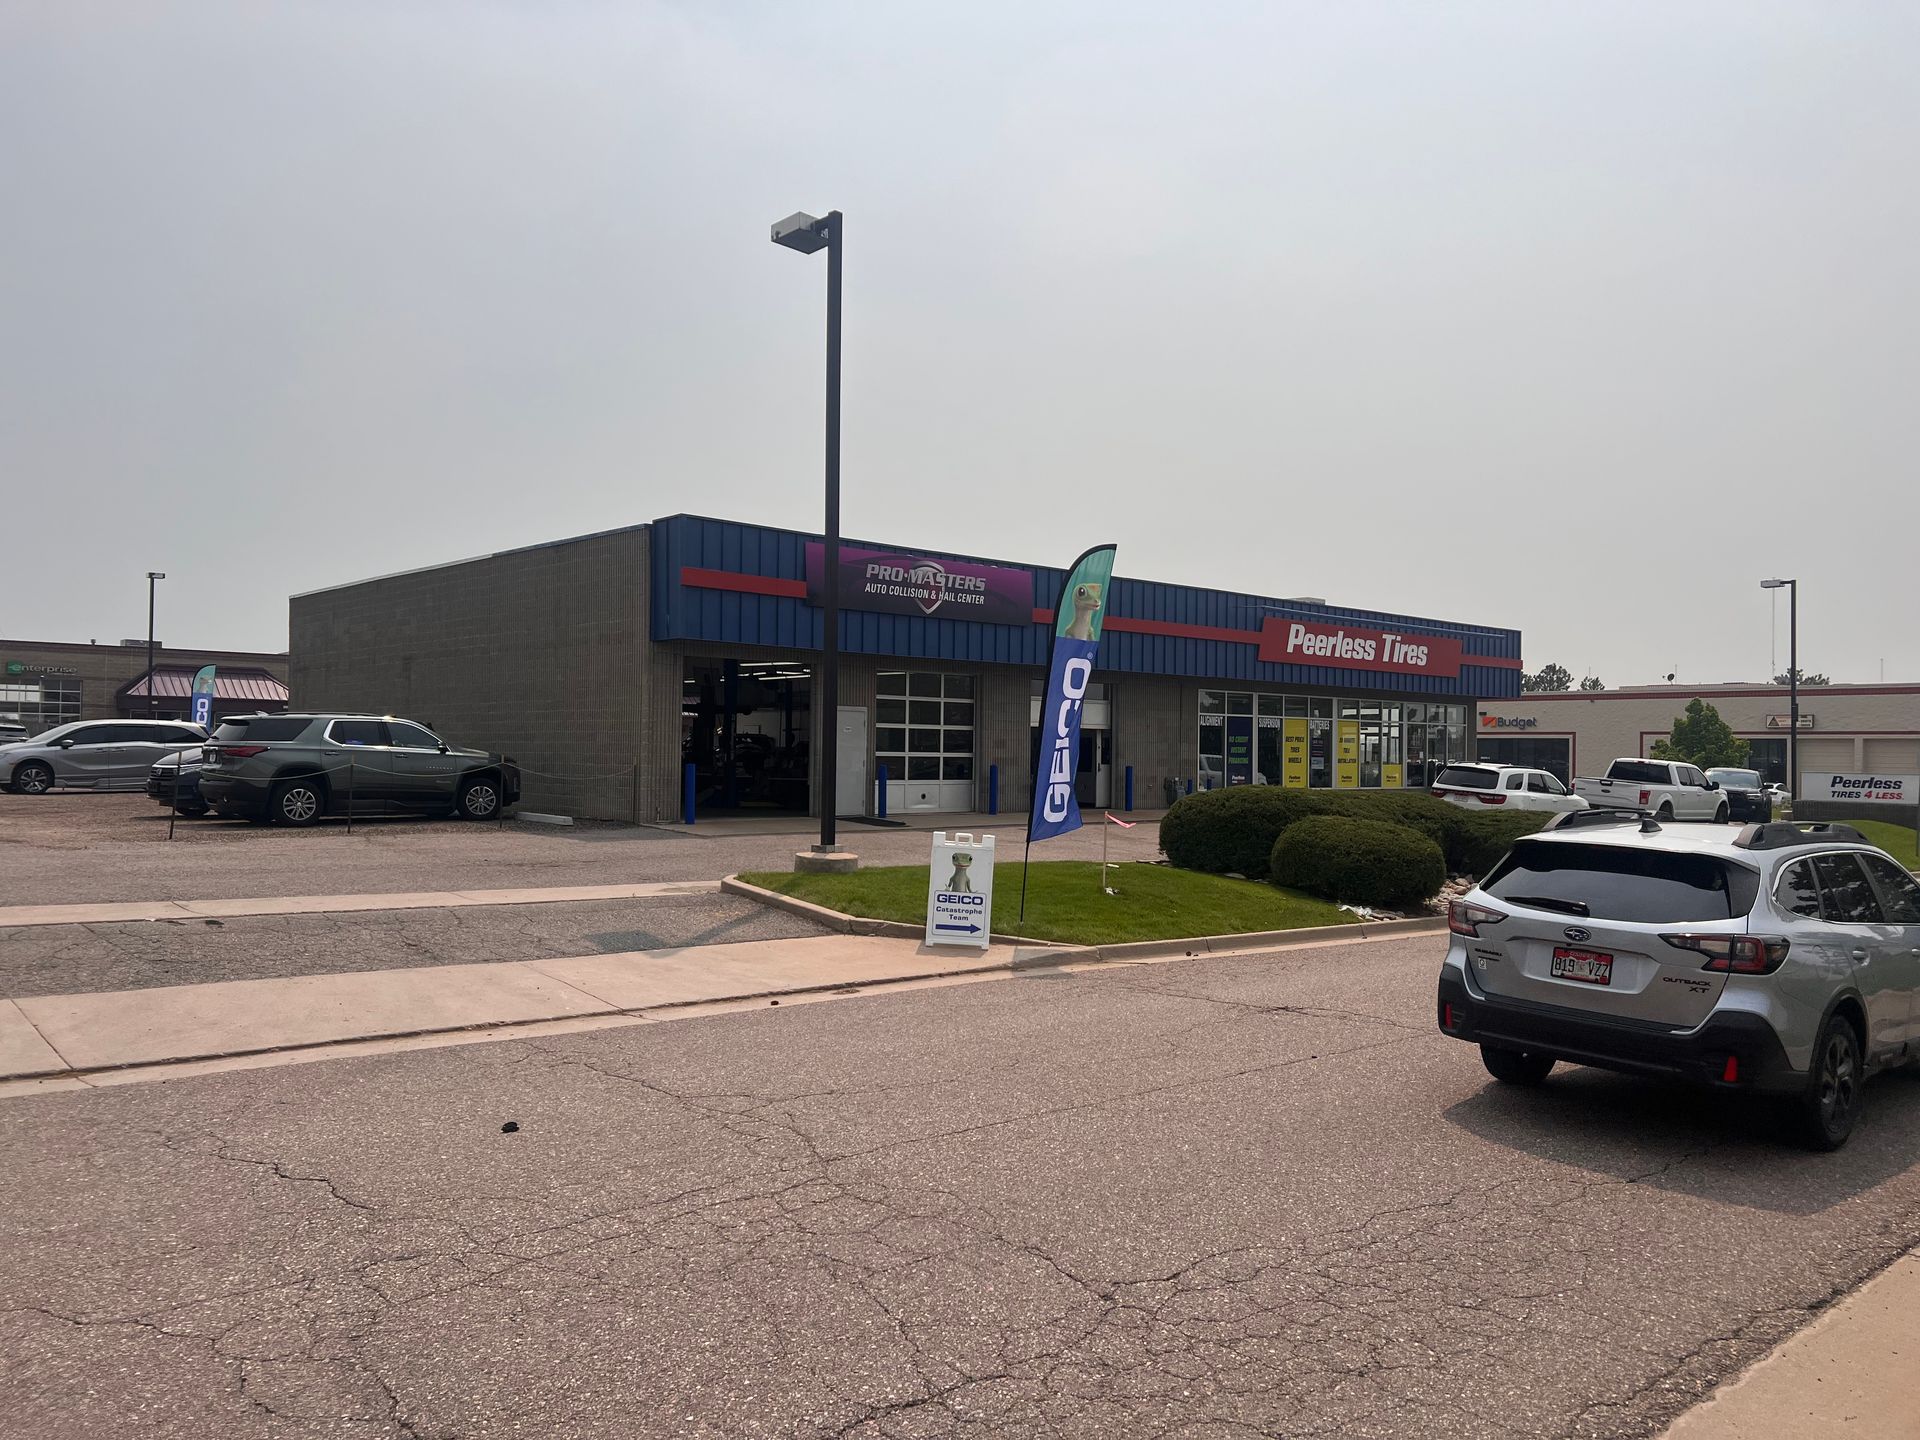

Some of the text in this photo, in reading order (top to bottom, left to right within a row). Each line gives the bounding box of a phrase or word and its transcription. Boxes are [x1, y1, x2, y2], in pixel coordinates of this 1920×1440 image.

[865, 583, 985, 605] AUTO COLLISION & HAIL CENTER
[1286, 623, 1428, 666] Peerless Tires
[8, 663, 78, 673] enterprise
[1200, 716, 1223, 727] ALIGNMENT
[1497, 717, 1537, 729] Budget
[1043, 656, 1093, 824] GEICO
[1830, 775, 1903, 789] Peerless
[1831, 790, 1861, 798] TIRES
[1864, 790, 1873, 799] 4
[936, 893, 984, 905] GEICO
[935, 906, 983, 915] Catastrophe
[1553, 956, 1610, 978] 819 VZZ
[1662, 976, 1712, 987] OUTBACK
